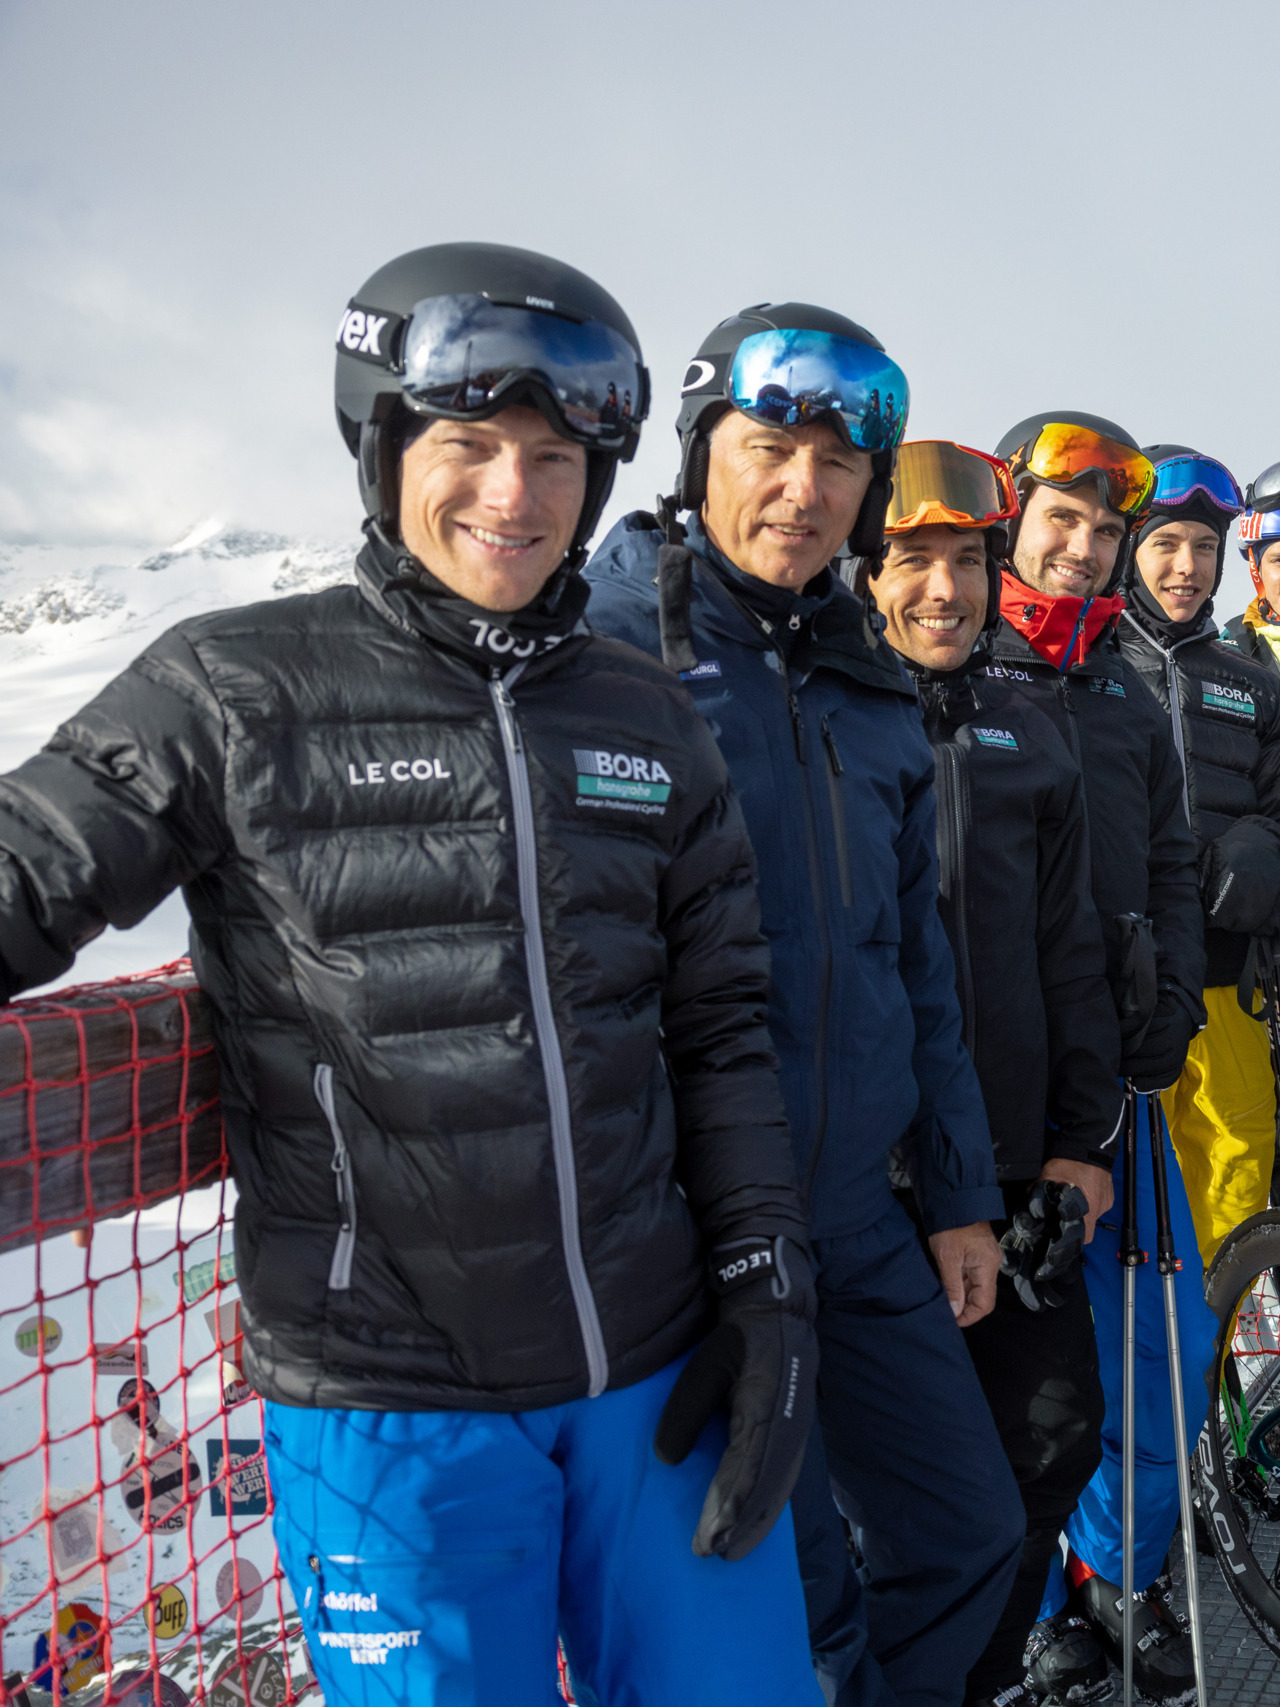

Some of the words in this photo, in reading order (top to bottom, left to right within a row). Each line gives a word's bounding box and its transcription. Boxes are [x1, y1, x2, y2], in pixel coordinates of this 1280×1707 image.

[335, 308, 388, 356] vex
[986, 666, 1004, 678] LE
[1213, 683, 1254, 704] BORA
[981, 728, 1015, 740] BORA
[348, 762, 386, 786] LE
[390, 758, 452, 782] COL
[594, 750, 673, 784] BORA
[718, 1259, 748, 1283] COL
[749, 1251, 772, 1269] LE
